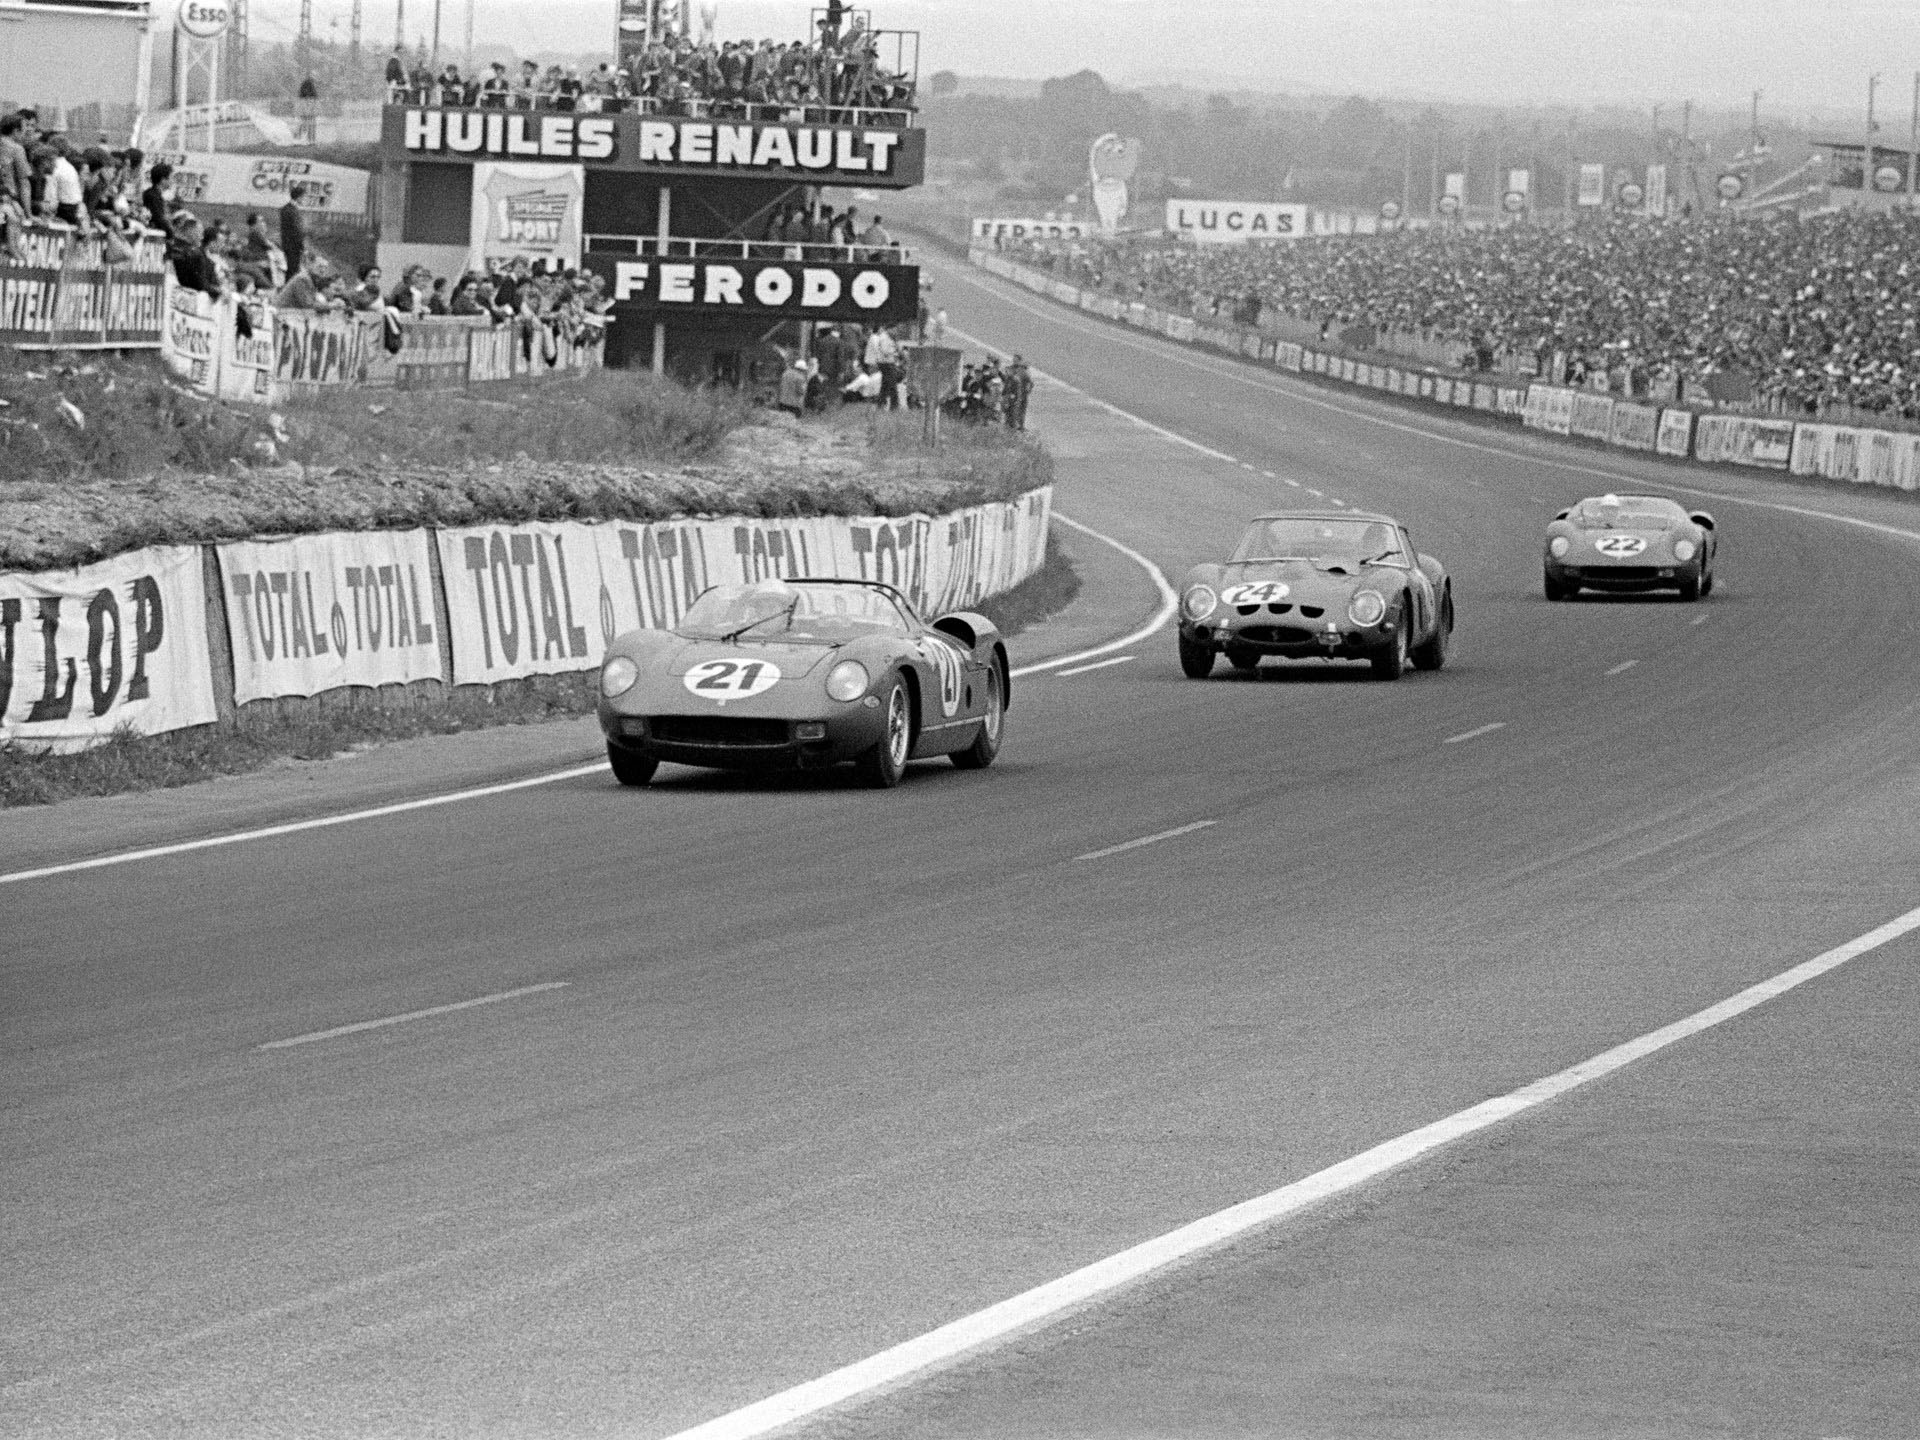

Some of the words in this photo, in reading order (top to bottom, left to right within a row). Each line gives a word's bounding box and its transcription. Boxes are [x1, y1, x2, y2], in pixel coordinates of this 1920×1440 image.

[188, 3, 227, 22] Esso
[404, 110, 614, 158] HUILES
[640, 121, 898, 171] RENAULT
[1178, 208, 1294, 233] LUCAS
[615, 262, 890, 309] FERODO
[107, 283, 165, 332] MARTELL
[1602, 537, 1641, 551] 22
[464, 531, 588, 670] TOTAL
[1232, 583, 1277, 602] 24
[231, 570, 328, 662] TOTAL
[346, 563, 433, 652] TOTAL
[696, 662, 764, 690] 21
